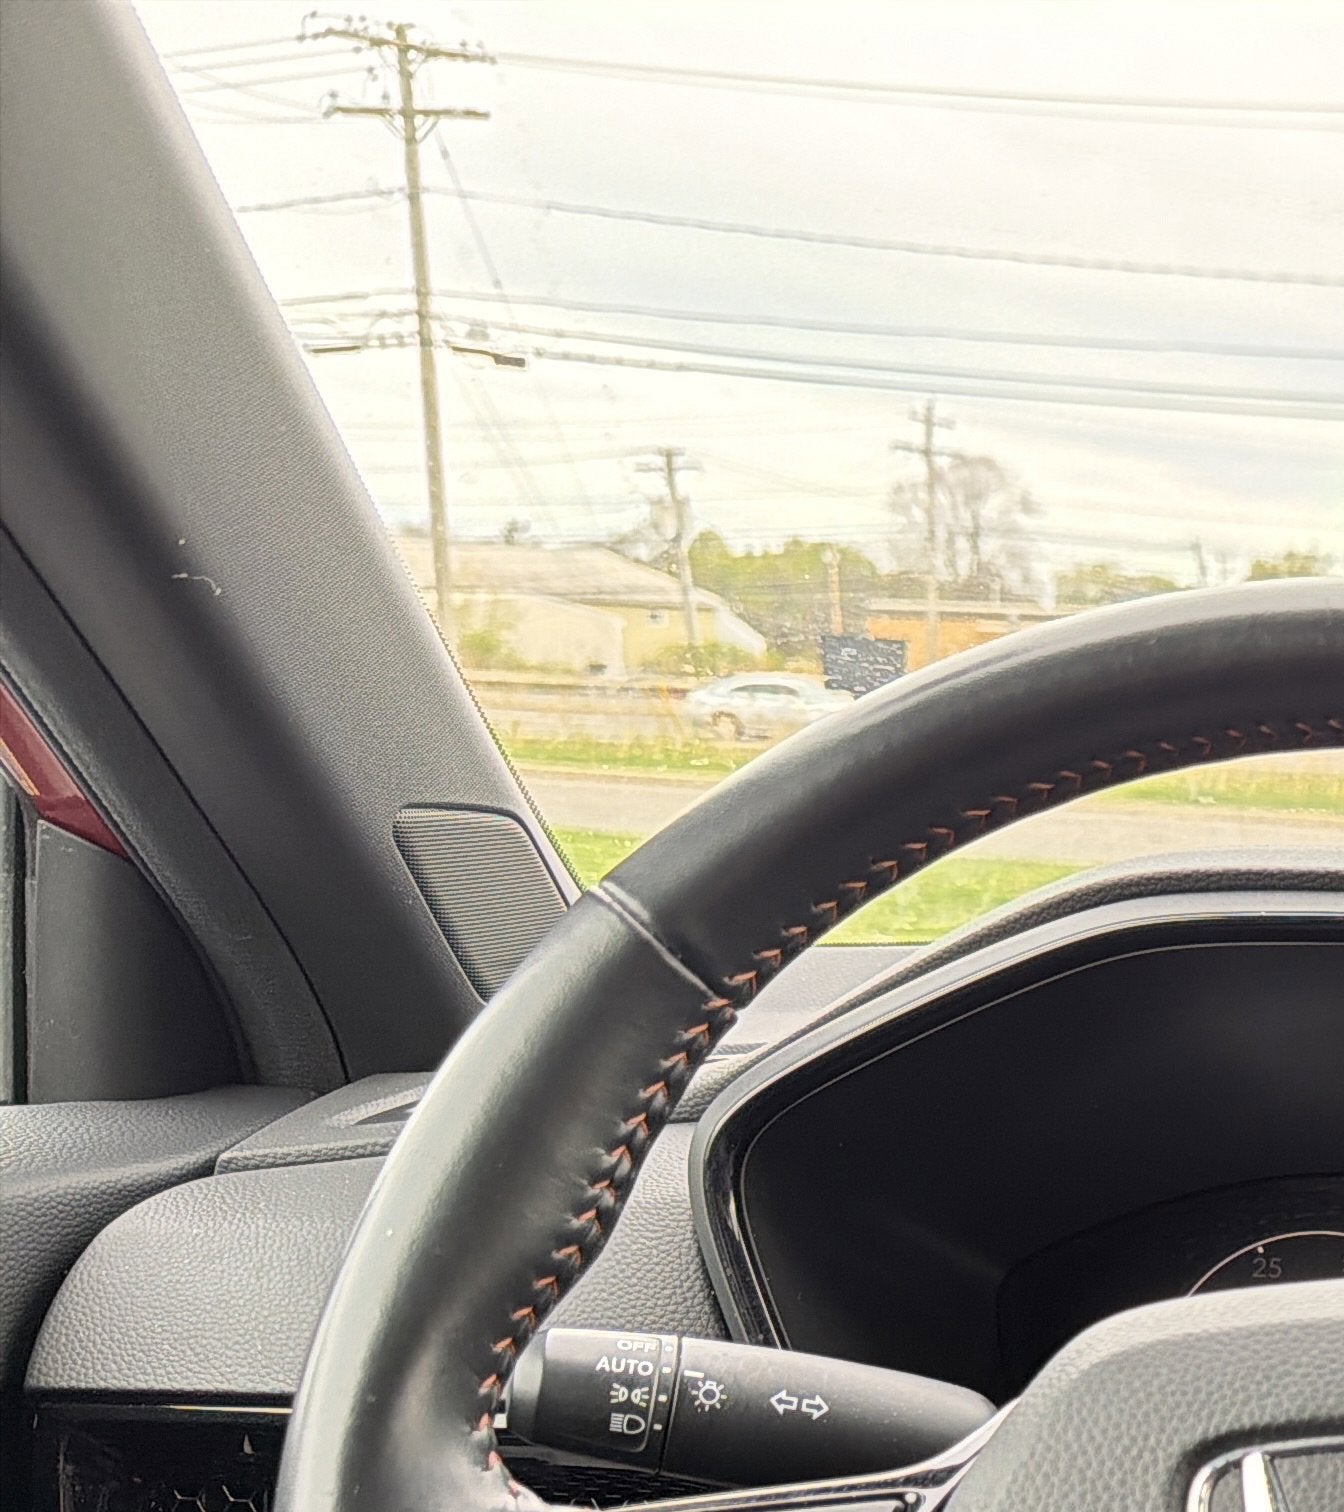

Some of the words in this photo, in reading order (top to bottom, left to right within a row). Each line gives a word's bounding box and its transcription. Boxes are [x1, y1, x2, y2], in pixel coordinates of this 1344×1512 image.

[1252, 1258, 1283, 1278] 25
[616, 1338, 658, 1352] OFF
[596, 1356, 654, 1376] AUTO
